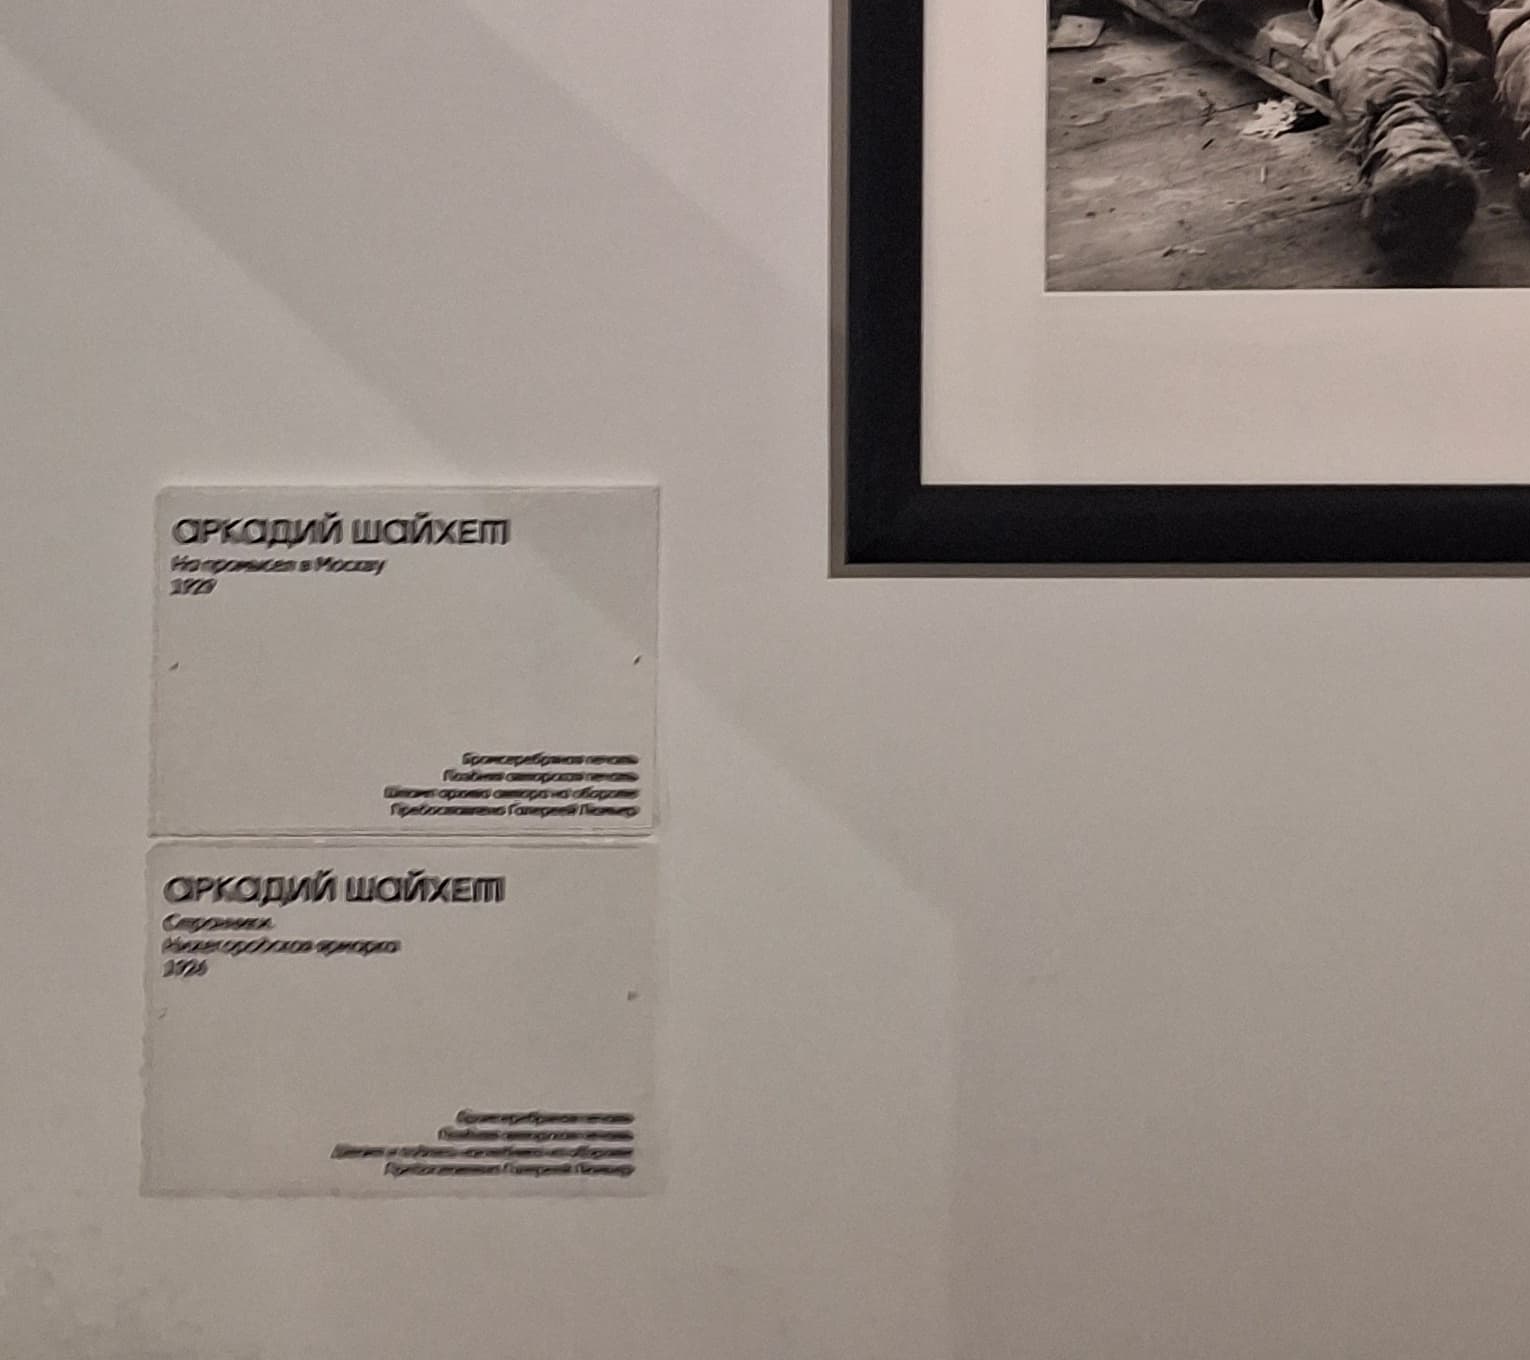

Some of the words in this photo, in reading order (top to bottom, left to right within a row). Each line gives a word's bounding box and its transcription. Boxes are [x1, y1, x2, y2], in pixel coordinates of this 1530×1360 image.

[171, 511, 345, 549] АРКАДИЙ
[351, 511, 512, 545] ШАЙХЕТ
[313, 556, 386, 576] Москву
[163, 869, 337, 907] АРКАДИЙ
[344, 869, 506, 903] ШАЙХЕТ
